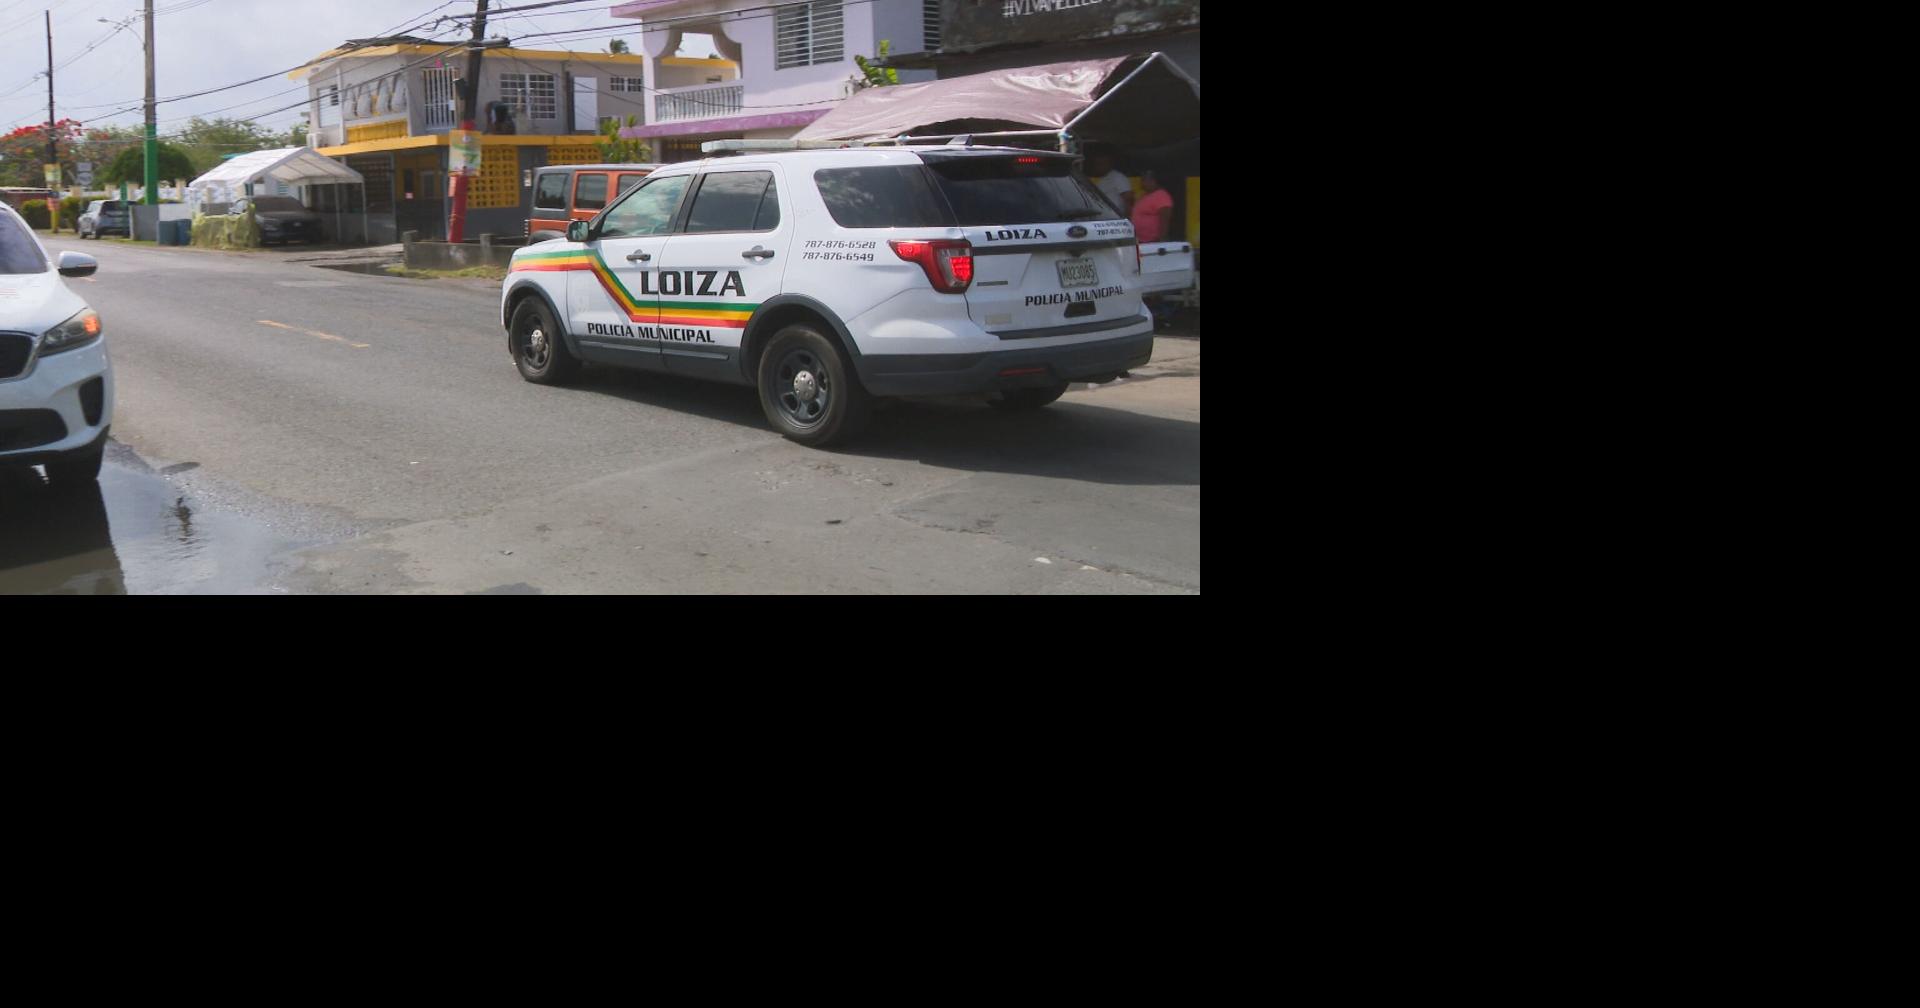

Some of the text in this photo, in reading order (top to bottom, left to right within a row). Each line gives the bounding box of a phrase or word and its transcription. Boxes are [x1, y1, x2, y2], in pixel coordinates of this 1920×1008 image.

[985, 228, 1047, 241] LOIZA
[804, 240, 876, 249] 787-876-6528
[802, 252, 874, 261] 787-876-6549
[640, 270, 746, 297] LOIZA
[1024, 285, 1125, 307] POLICIA MUNICIPAL
[587, 322, 716, 344] POLICIA MUNICIPAL
